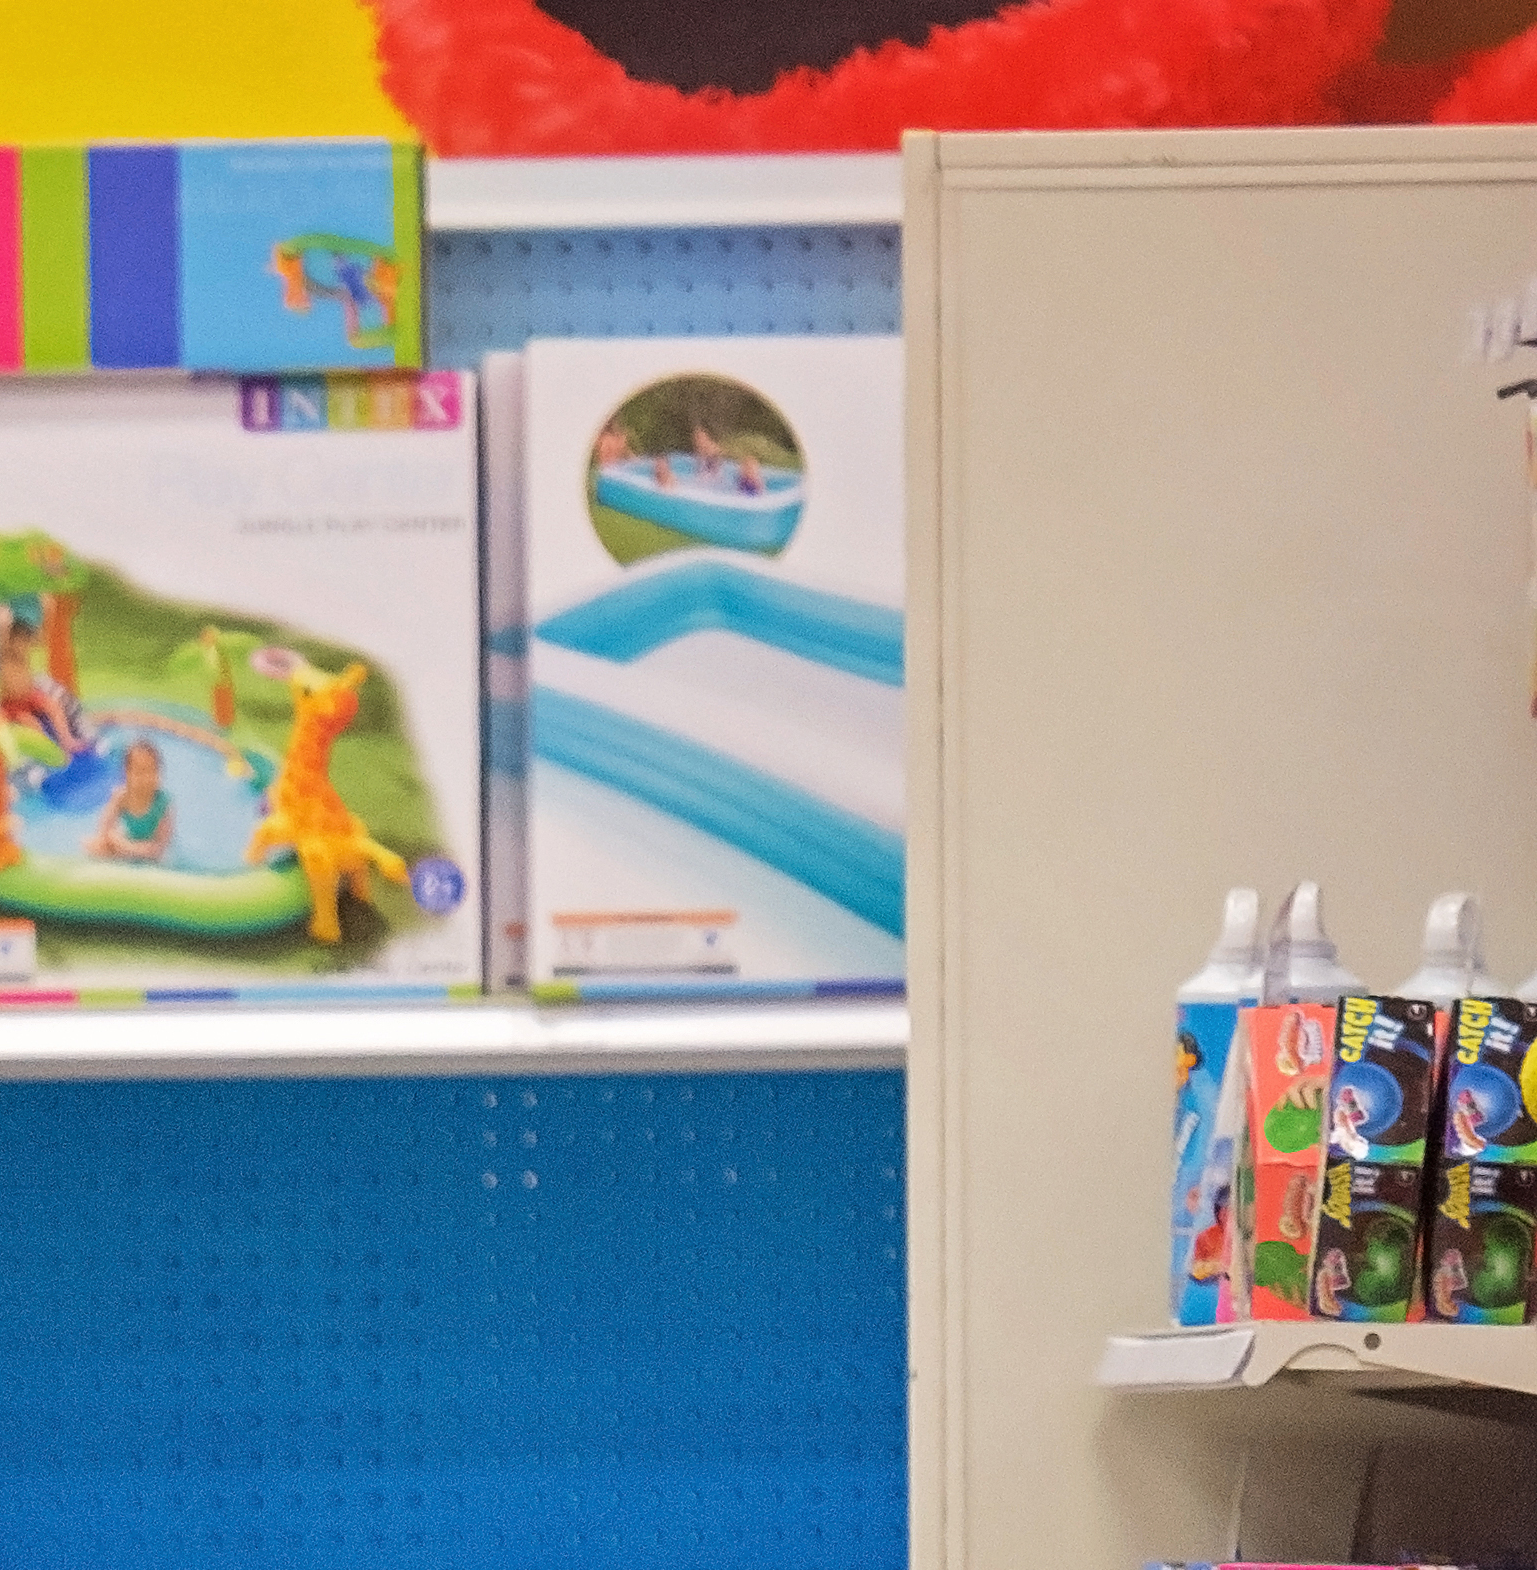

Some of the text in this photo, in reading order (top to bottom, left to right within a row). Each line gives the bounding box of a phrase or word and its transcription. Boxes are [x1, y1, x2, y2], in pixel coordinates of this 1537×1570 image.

[247, 383, 458, 430] INTEX
[1340, 997, 1377, 1063] CATCH
[1457, 998, 1493, 1065] CATCH
